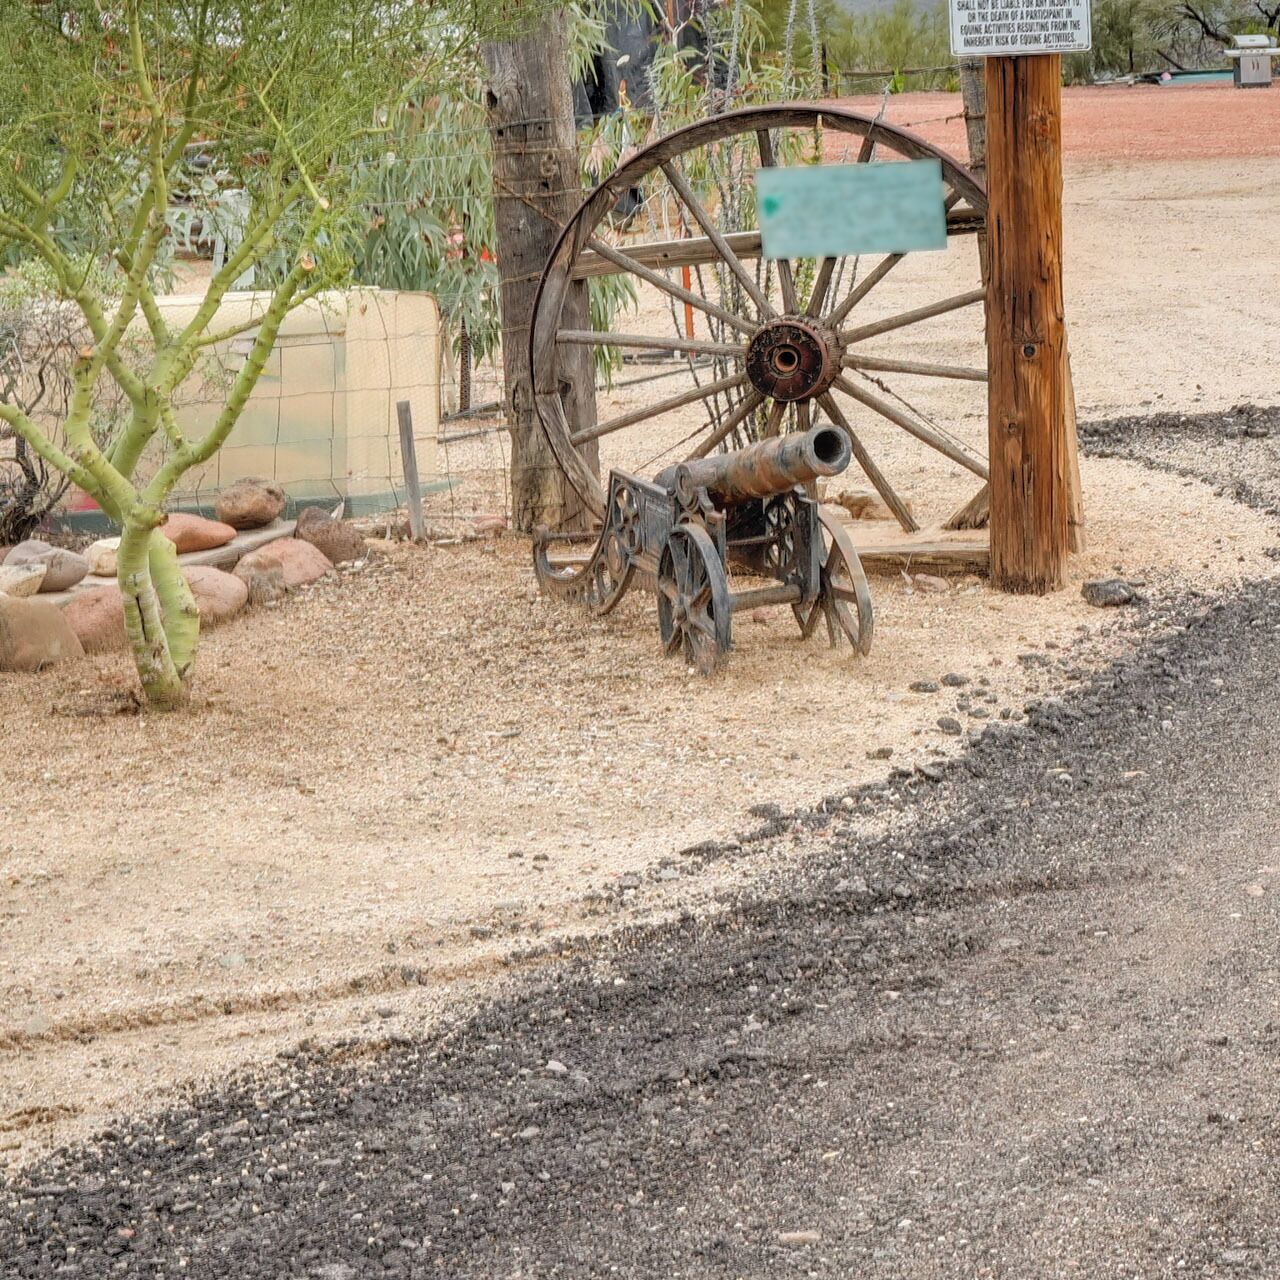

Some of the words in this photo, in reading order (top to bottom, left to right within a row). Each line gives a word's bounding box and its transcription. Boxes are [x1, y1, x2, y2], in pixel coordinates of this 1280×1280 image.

[957, 0, 976, 11] SHALL
[978, 0, 989, 10] NOT
[991, 0, 999, 9] BE
[968, 12, 976, 22] OR
[978, 11, 988, 22] THE
[990, 11, 1009, 21] DEATH
[1011, 10, 1018, 21] OF
[1020, 10, 1025, 20] A
[1026, 9, 1064, 20] PARTICIPANT
[1066, 8, 1073, 19] IN
[961, 24, 982, 35] EQUINE
[984, 22, 1015, 34] ACTIVITIES
[1017, 21, 1050, 32] RESULTING
[1051, 20, 1068, 31] FROM
[1070, 20, 1080, 30] THE
[964, 36, 993, 47] INHERENT
[995, 35, 1009, 46] RISK
[1010, 34, 1018, 45] OF
[1020, 33, 1041, 45] EQUINE
[1043, 32, 1077, 43] ACTIVITIES.
